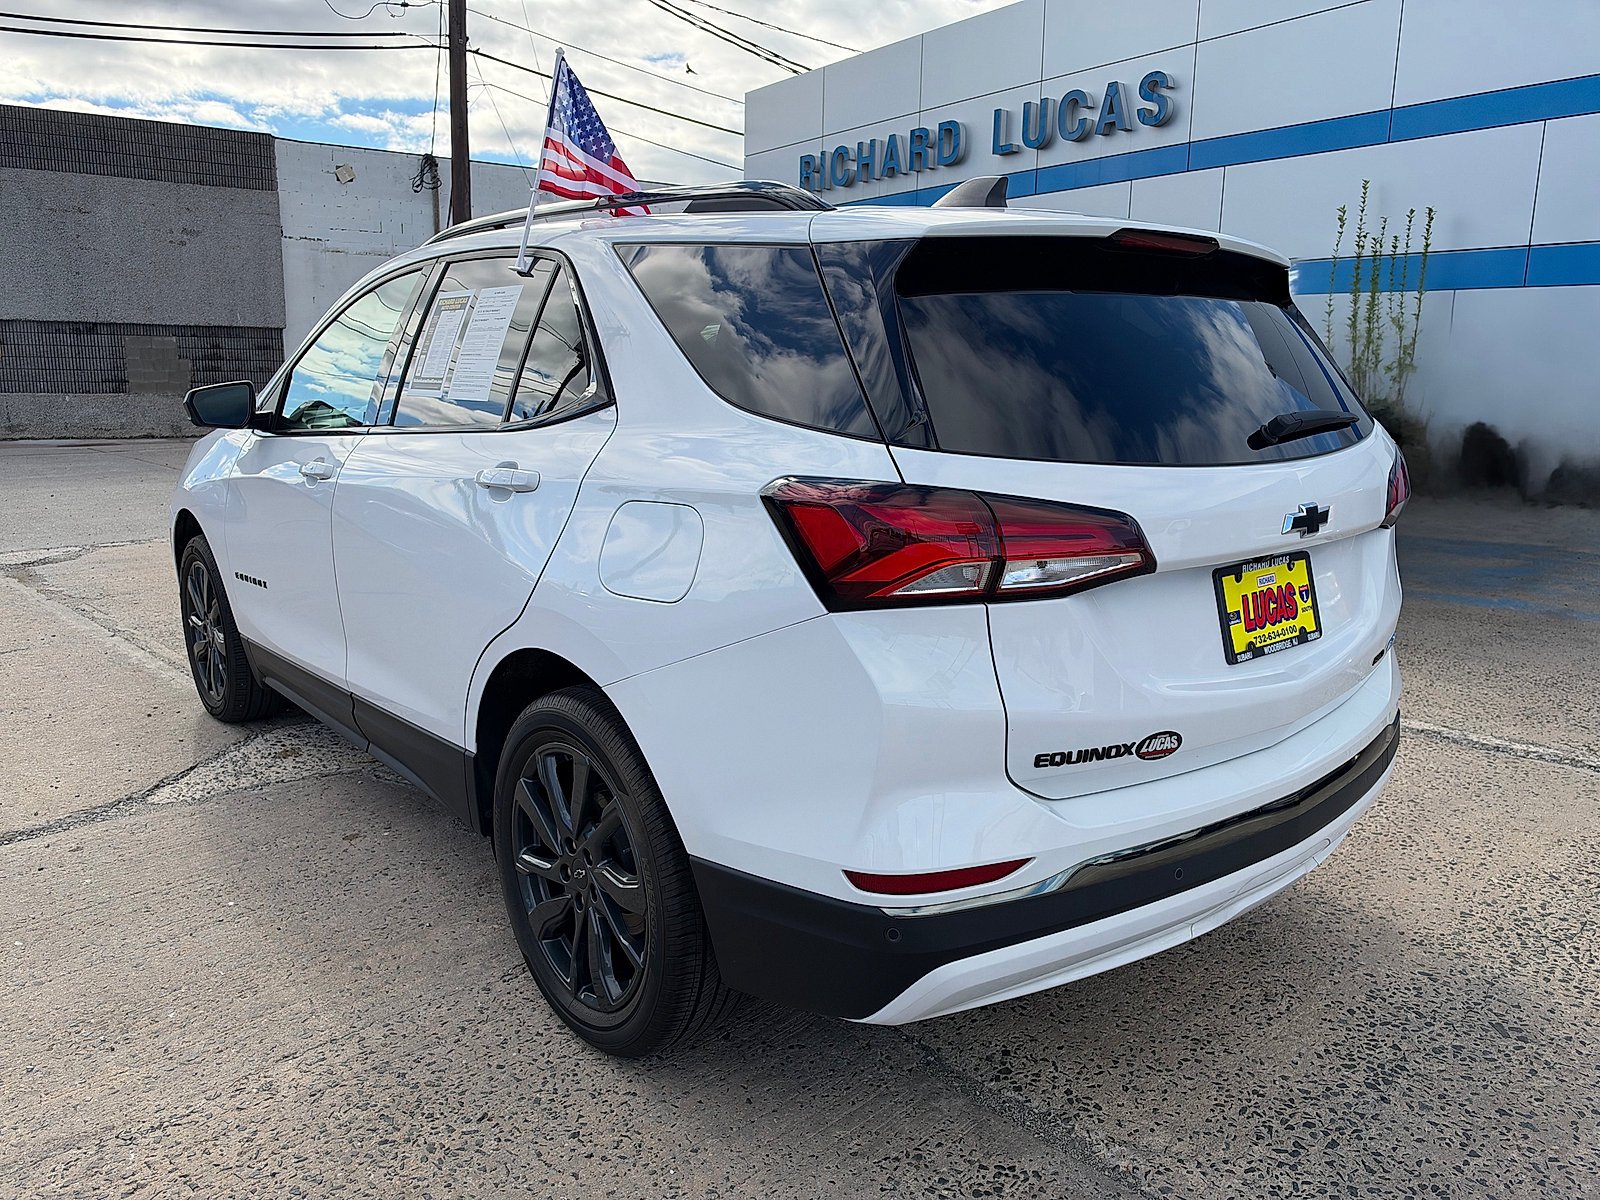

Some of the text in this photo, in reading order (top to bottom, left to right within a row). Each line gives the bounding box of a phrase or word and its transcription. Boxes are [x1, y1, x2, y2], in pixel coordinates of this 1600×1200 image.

[799, 70, 1176, 192] RICHARD LUCAS
[1271, 556, 1290, 566] LUCAS
[1302, 591, 1307, 601] 1
[1241, 582, 1299, 633] LUCAS
[1253, 624, 1298, 646] 732-634-0100
[1141, 735, 1178, 752] LUCAS
[1033, 742, 1137, 768] EQUINOX
